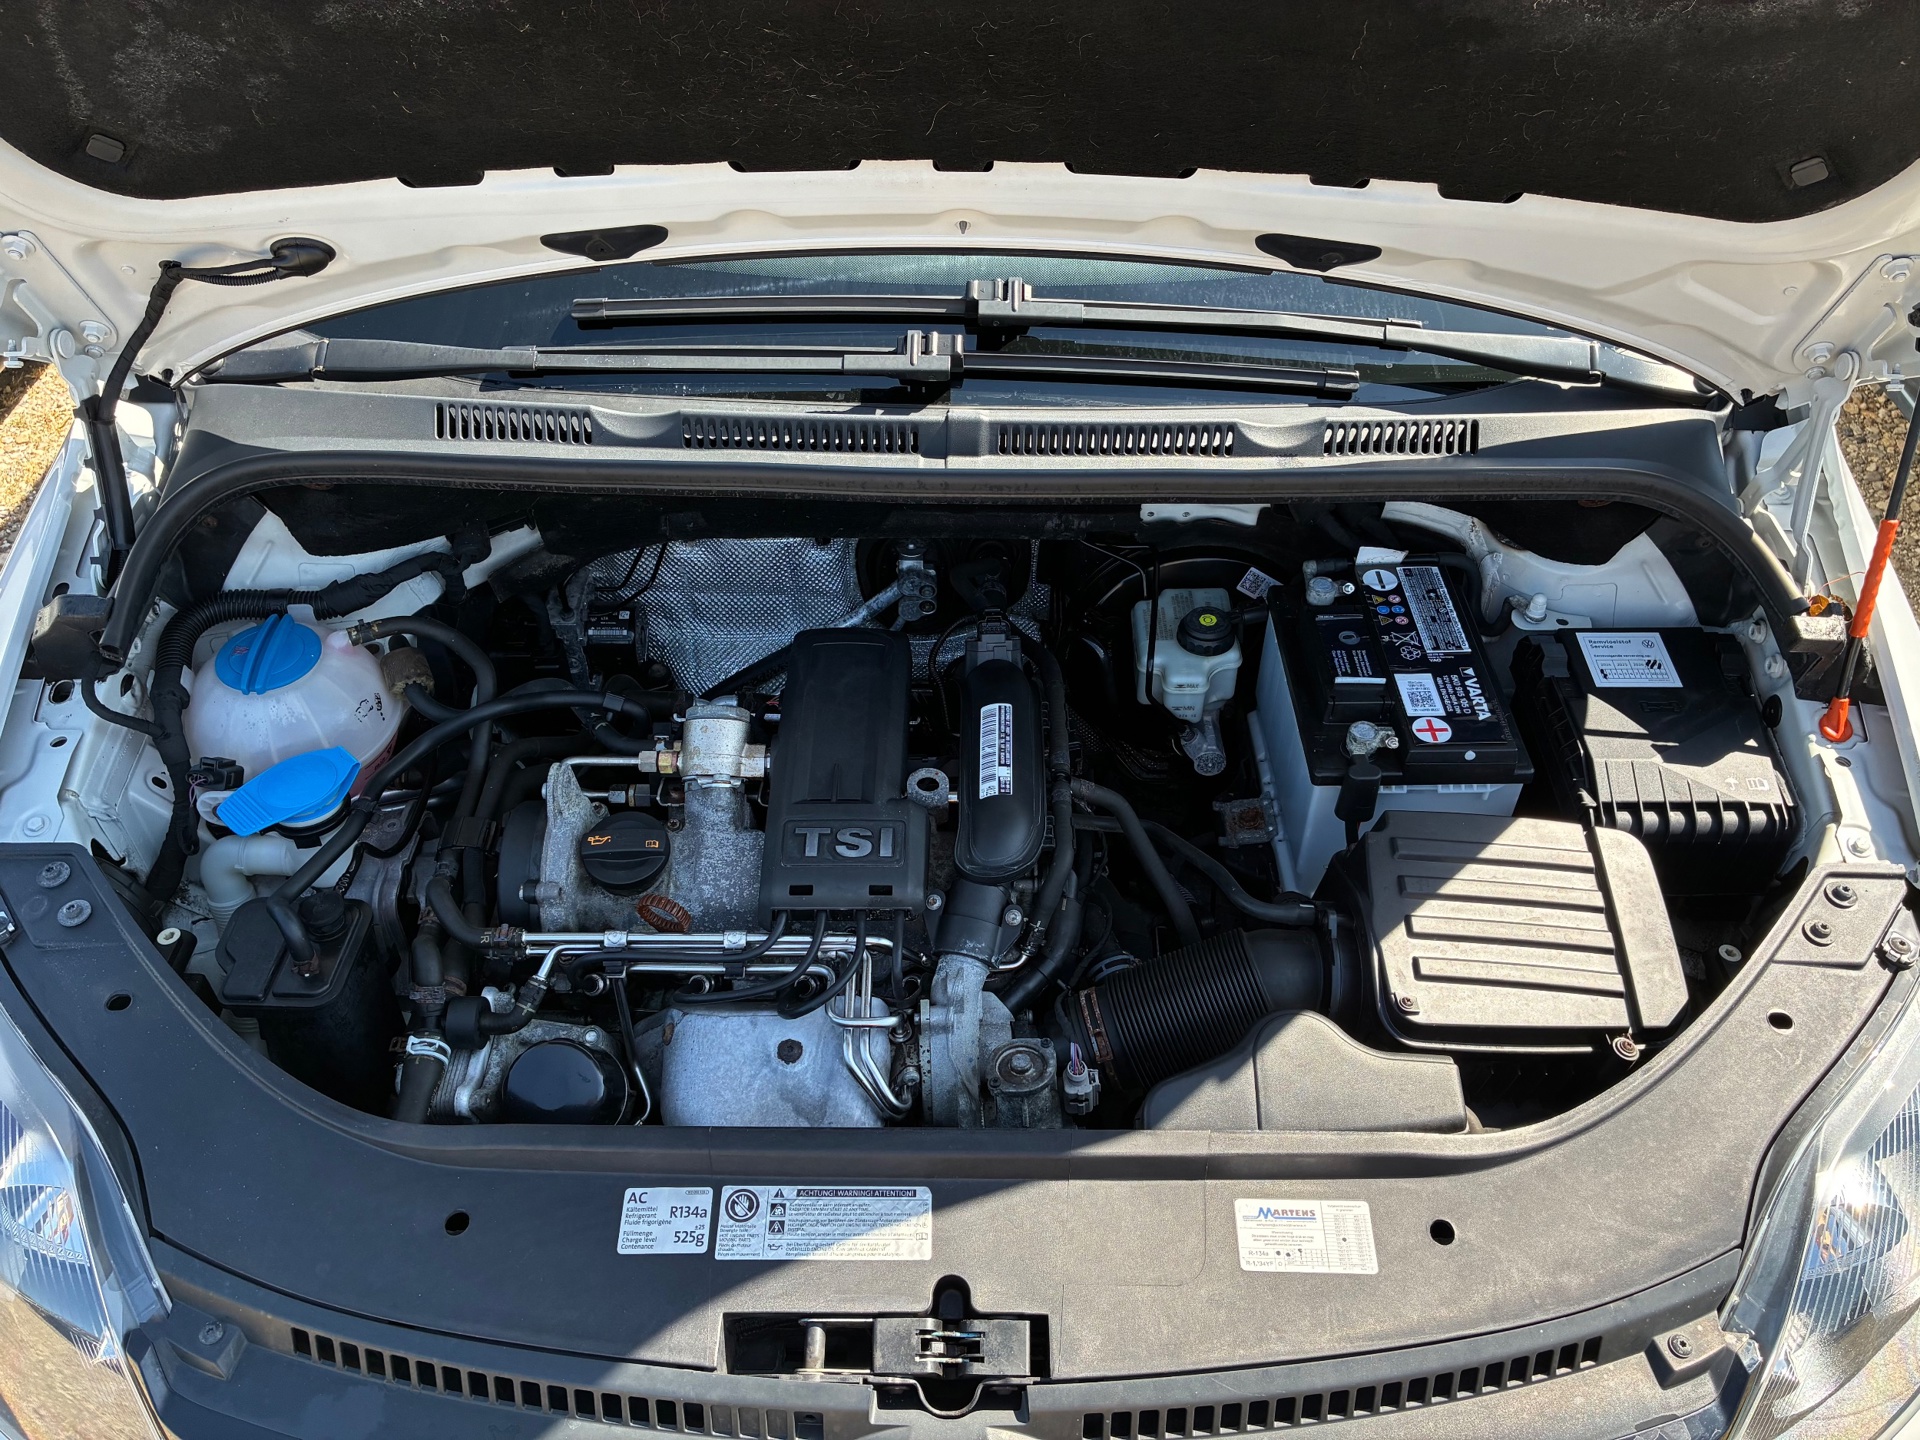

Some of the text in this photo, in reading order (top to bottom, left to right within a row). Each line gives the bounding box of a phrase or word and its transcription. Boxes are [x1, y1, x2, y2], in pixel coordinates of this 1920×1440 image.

[1455, 686, 1465, 696] 915
[1460, 698, 1470, 708] 105
[1464, 678, 1492, 720] VARTA
[795, 827, 894, 857] TSI
[627, 1192, 648, 1204] AC
[670, 1206, 708, 1218] R134a
[1258, 1206, 1316, 1220] MARTENS
[674, 1230, 705, 1247] 525g
